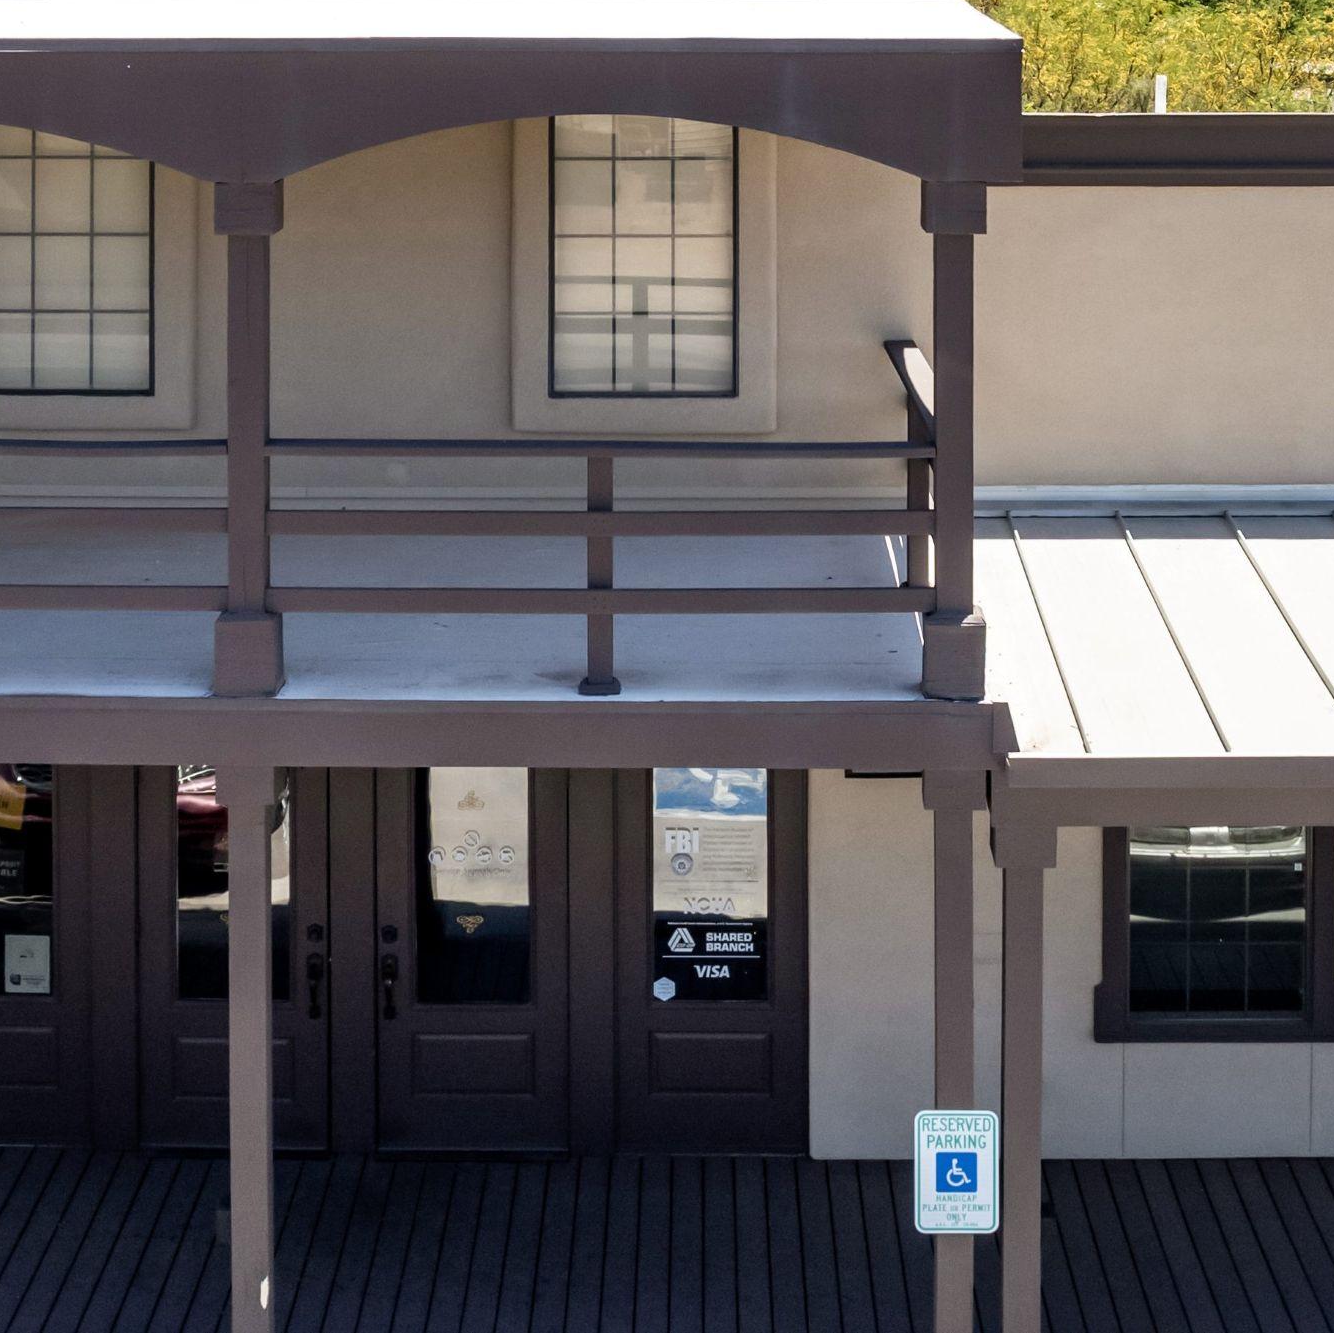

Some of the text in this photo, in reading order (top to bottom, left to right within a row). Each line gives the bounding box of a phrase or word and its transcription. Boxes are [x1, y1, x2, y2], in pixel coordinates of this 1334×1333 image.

[706, 932, 753, 942] SHARED
[706, 943, 754, 952] BRANCH
[693, 965, 730, 978] VISA
[922, 1117, 991, 1132] RESERVED
[926, 1134, 987, 1149] PARKING
[935, 1194, 978, 1203] HANDICAP
[922, 1204, 947, 1212] PLATE
[961, 1204, 991, 1212] PERMIT
[946, 1213, 968, 1221] ONLY
